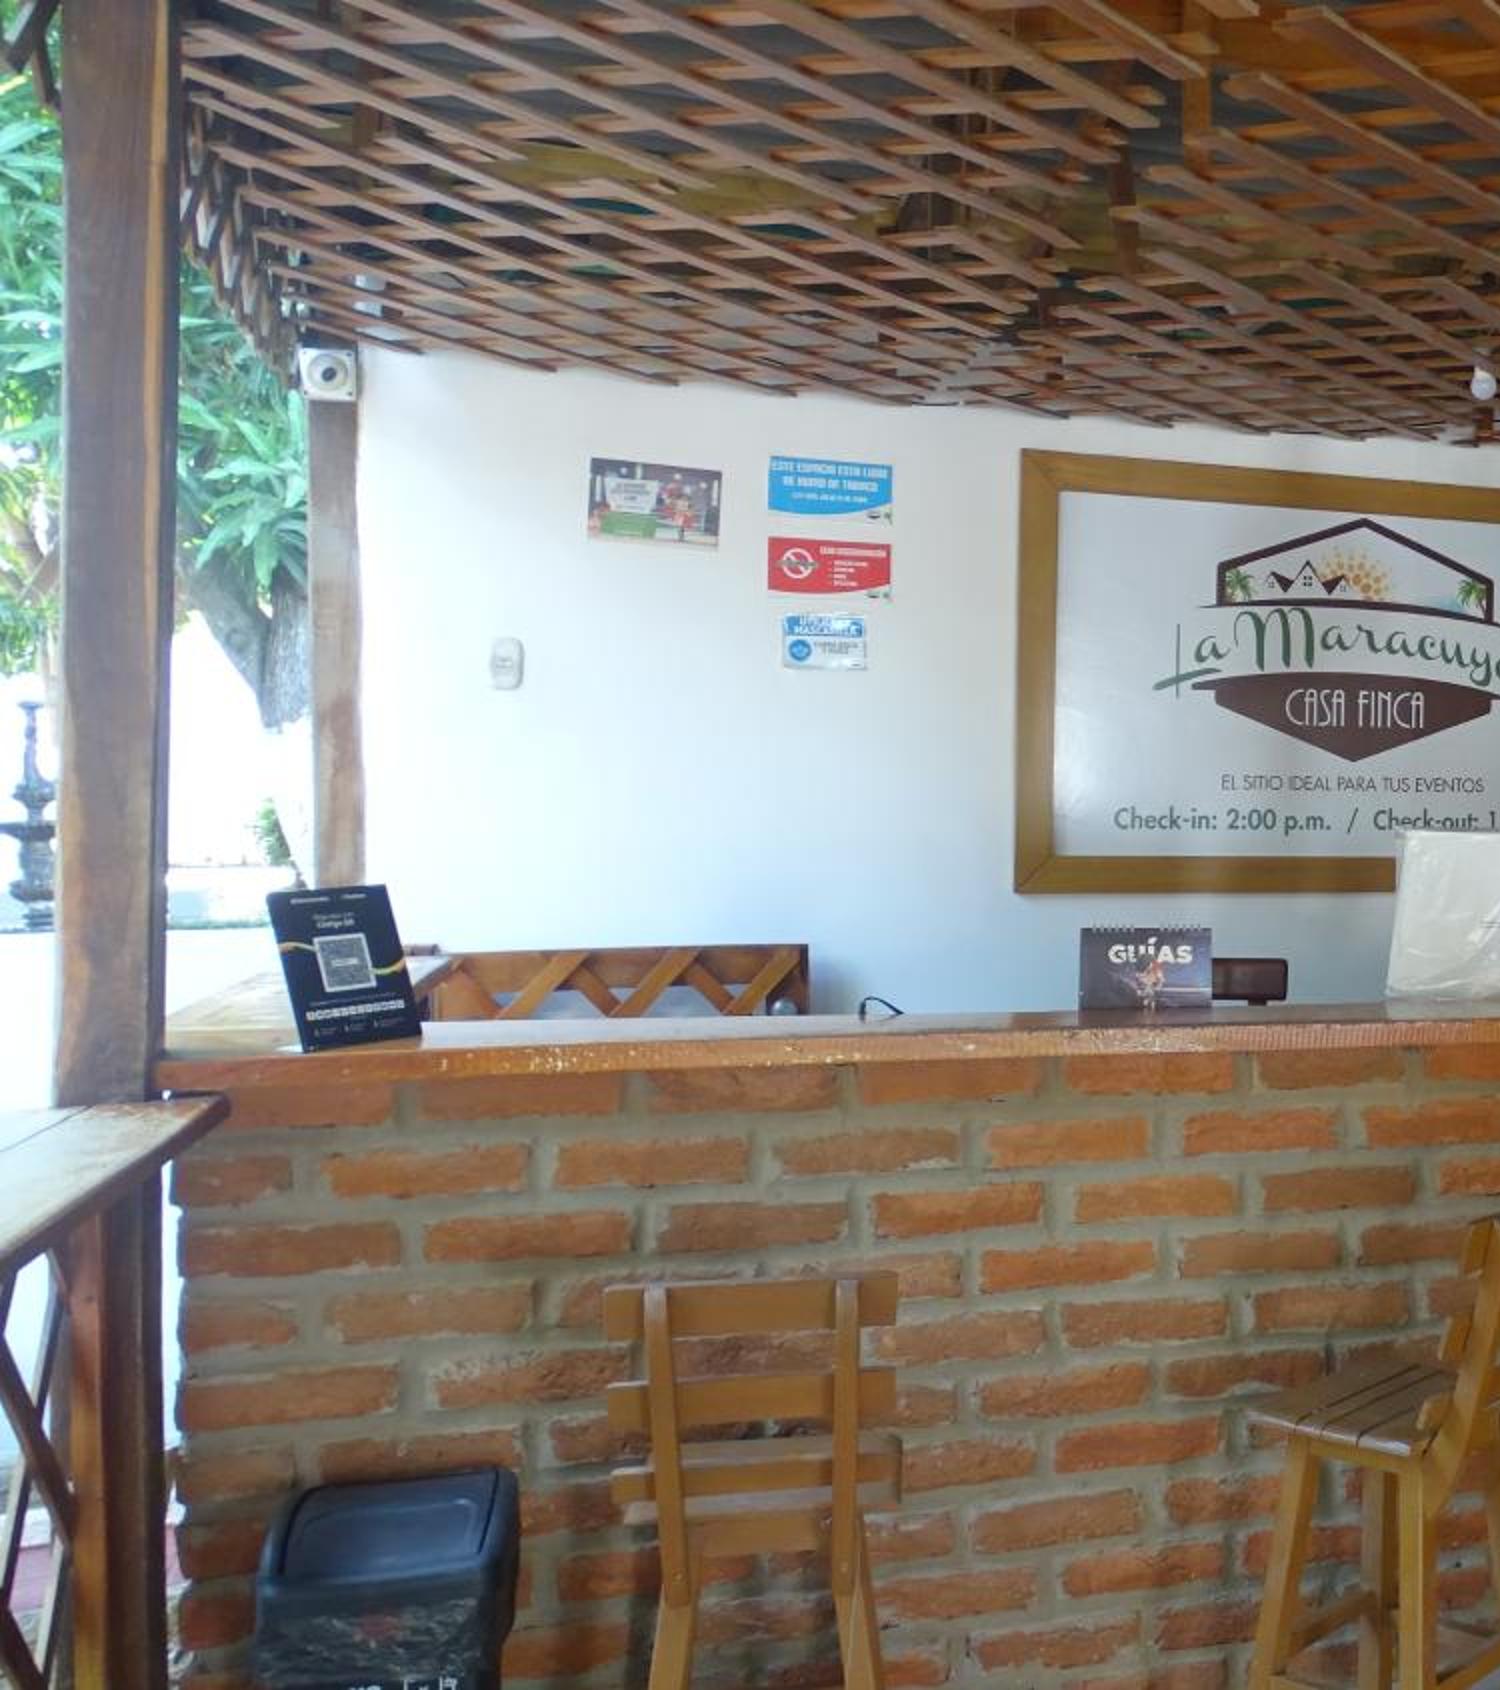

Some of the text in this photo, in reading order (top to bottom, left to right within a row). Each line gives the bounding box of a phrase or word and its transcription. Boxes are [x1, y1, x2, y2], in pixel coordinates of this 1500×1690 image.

[1152, 623, 1230, 699] La
[1285, 689, 1425, 730] CASA FINCA
[1221, 773, 1486, 793] EL SITIO IDEAL PARA TUS EVENTOS
[1113, 805, 1218, 831] Check-in:
[1226, 808, 1277, 831] 2:00
[1284, 812, 1332, 837] p.m.
[1107, 935, 1194, 964] GUÍAS
